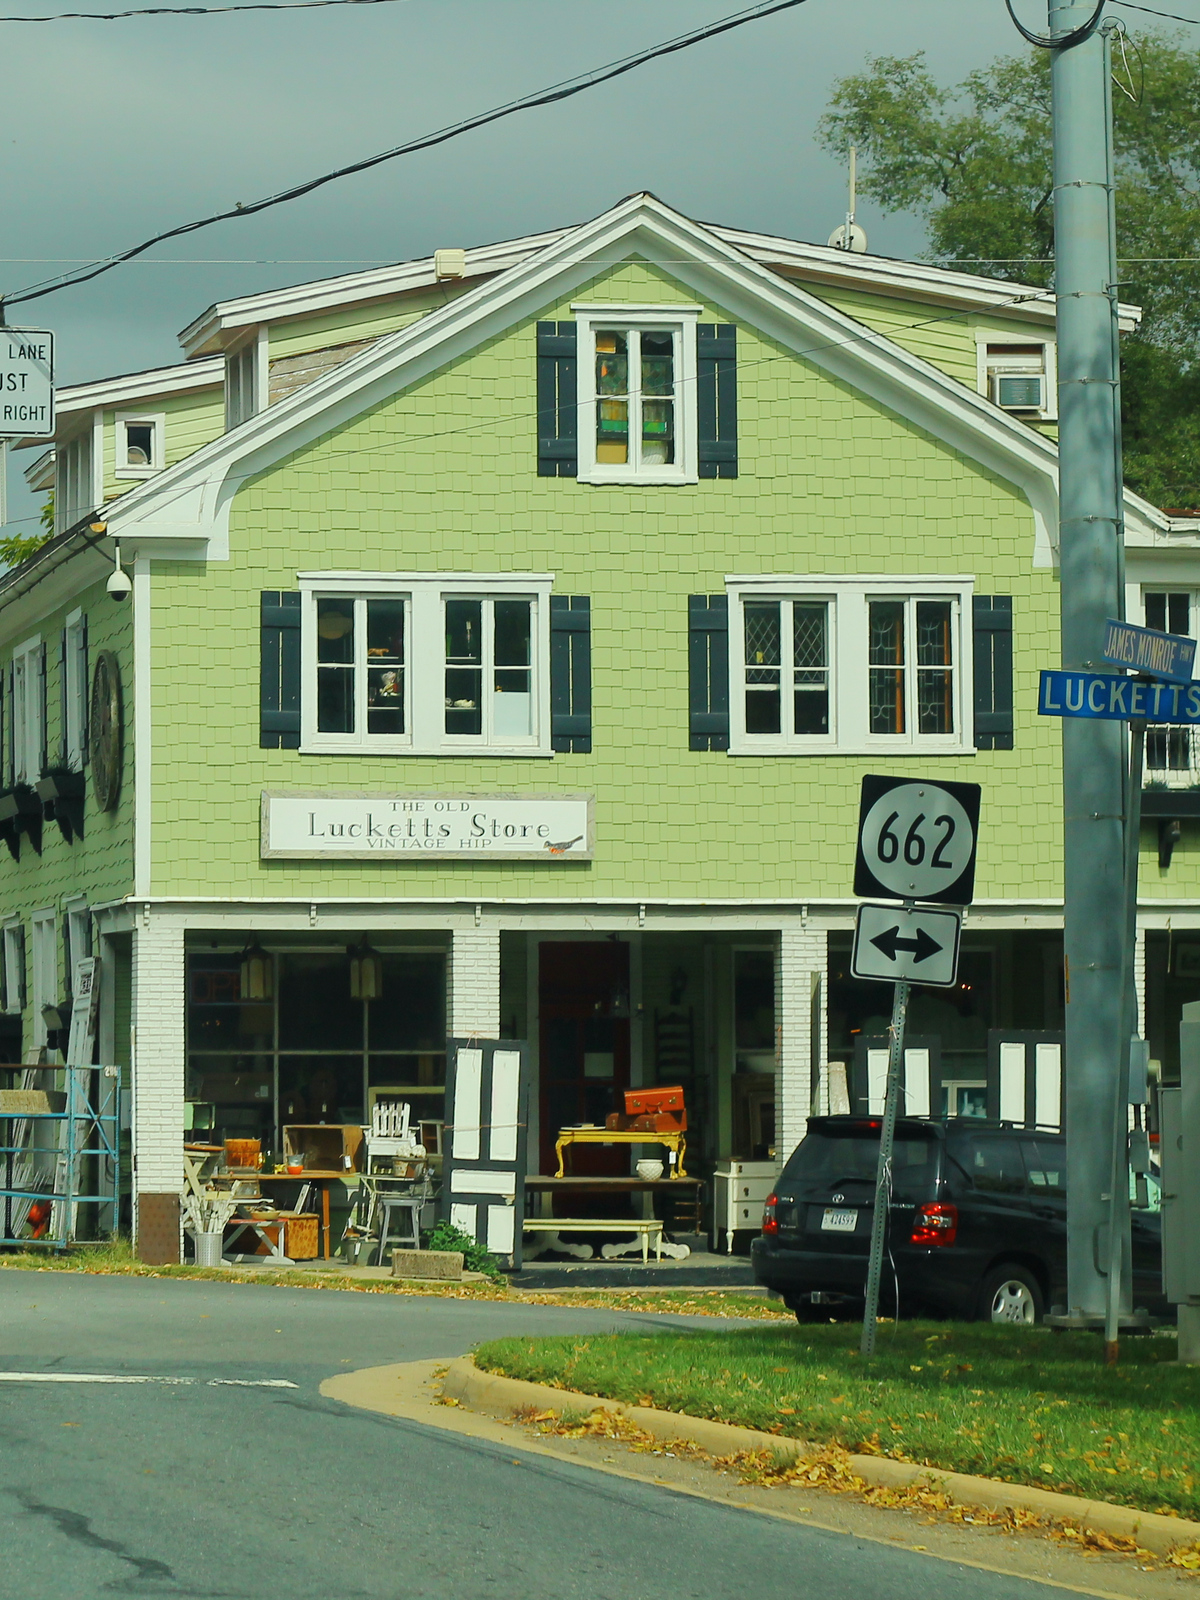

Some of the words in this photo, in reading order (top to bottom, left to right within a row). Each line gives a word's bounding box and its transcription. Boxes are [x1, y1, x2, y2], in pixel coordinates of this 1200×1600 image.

[8, 344, 47, 360] LANE
[4, 405, 47, 421] RIGHT
[1104, 626, 1136, 663] JAMES
[1136, 633, 1178, 674] MONROE
[1044, 676, 1200, 717] LUCKETTS
[388, 802, 425, 812] THE
[434, 802, 470, 812] OLD
[307, 812, 451, 838] Lucketts
[469, 813, 550, 838] Store
[367, 838, 446, 849] VINTAGE
[459, 838, 492, 849] HIP
[877, 810, 956, 869] 662
